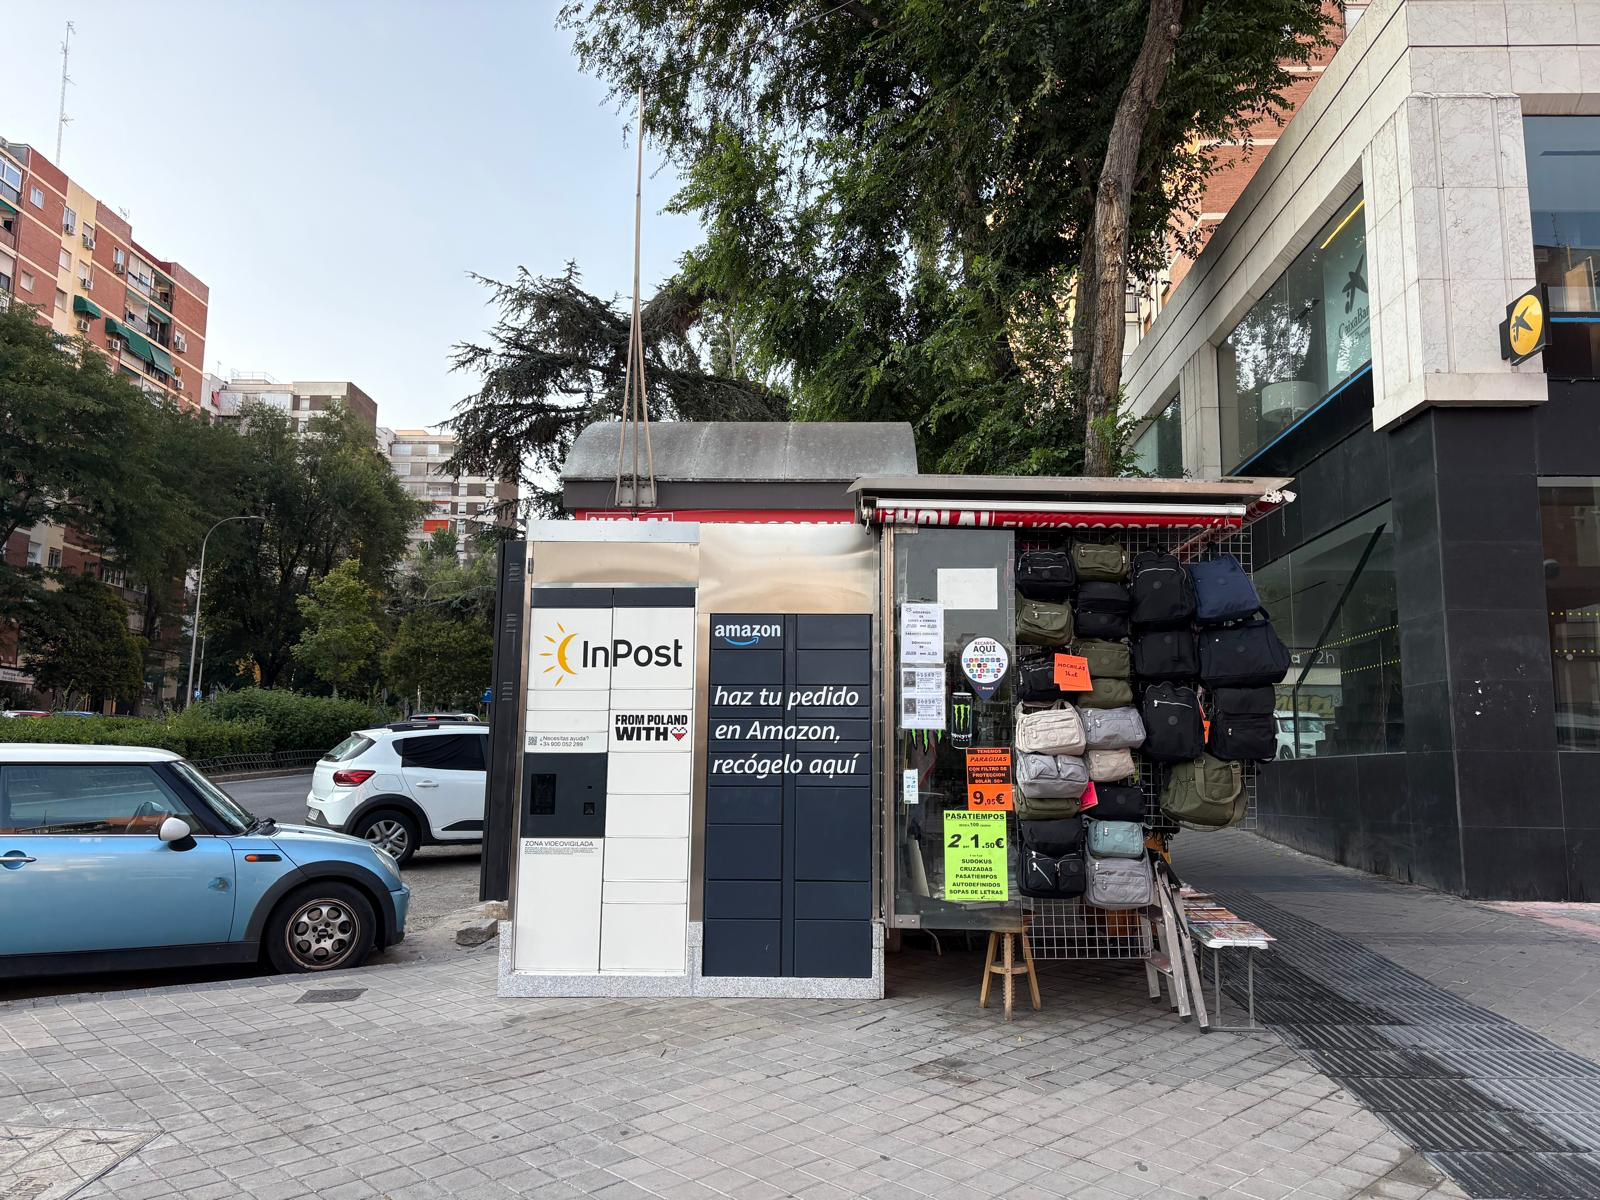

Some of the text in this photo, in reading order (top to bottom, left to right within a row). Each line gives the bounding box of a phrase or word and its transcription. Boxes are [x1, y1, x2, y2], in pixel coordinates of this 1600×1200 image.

[714, 624, 781, 637] amazon
[582, 639, 683, 668] InPost
[714, 686, 859, 711] haz tu pedido
[615, 714, 688, 726] FROM POLAND
[615, 726, 669, 742] WITH
[715, 721, 841, 744] en Amazon,
[712, 753, 860, 779] recógelo aquí
[947, 833, 962, 848] 2
